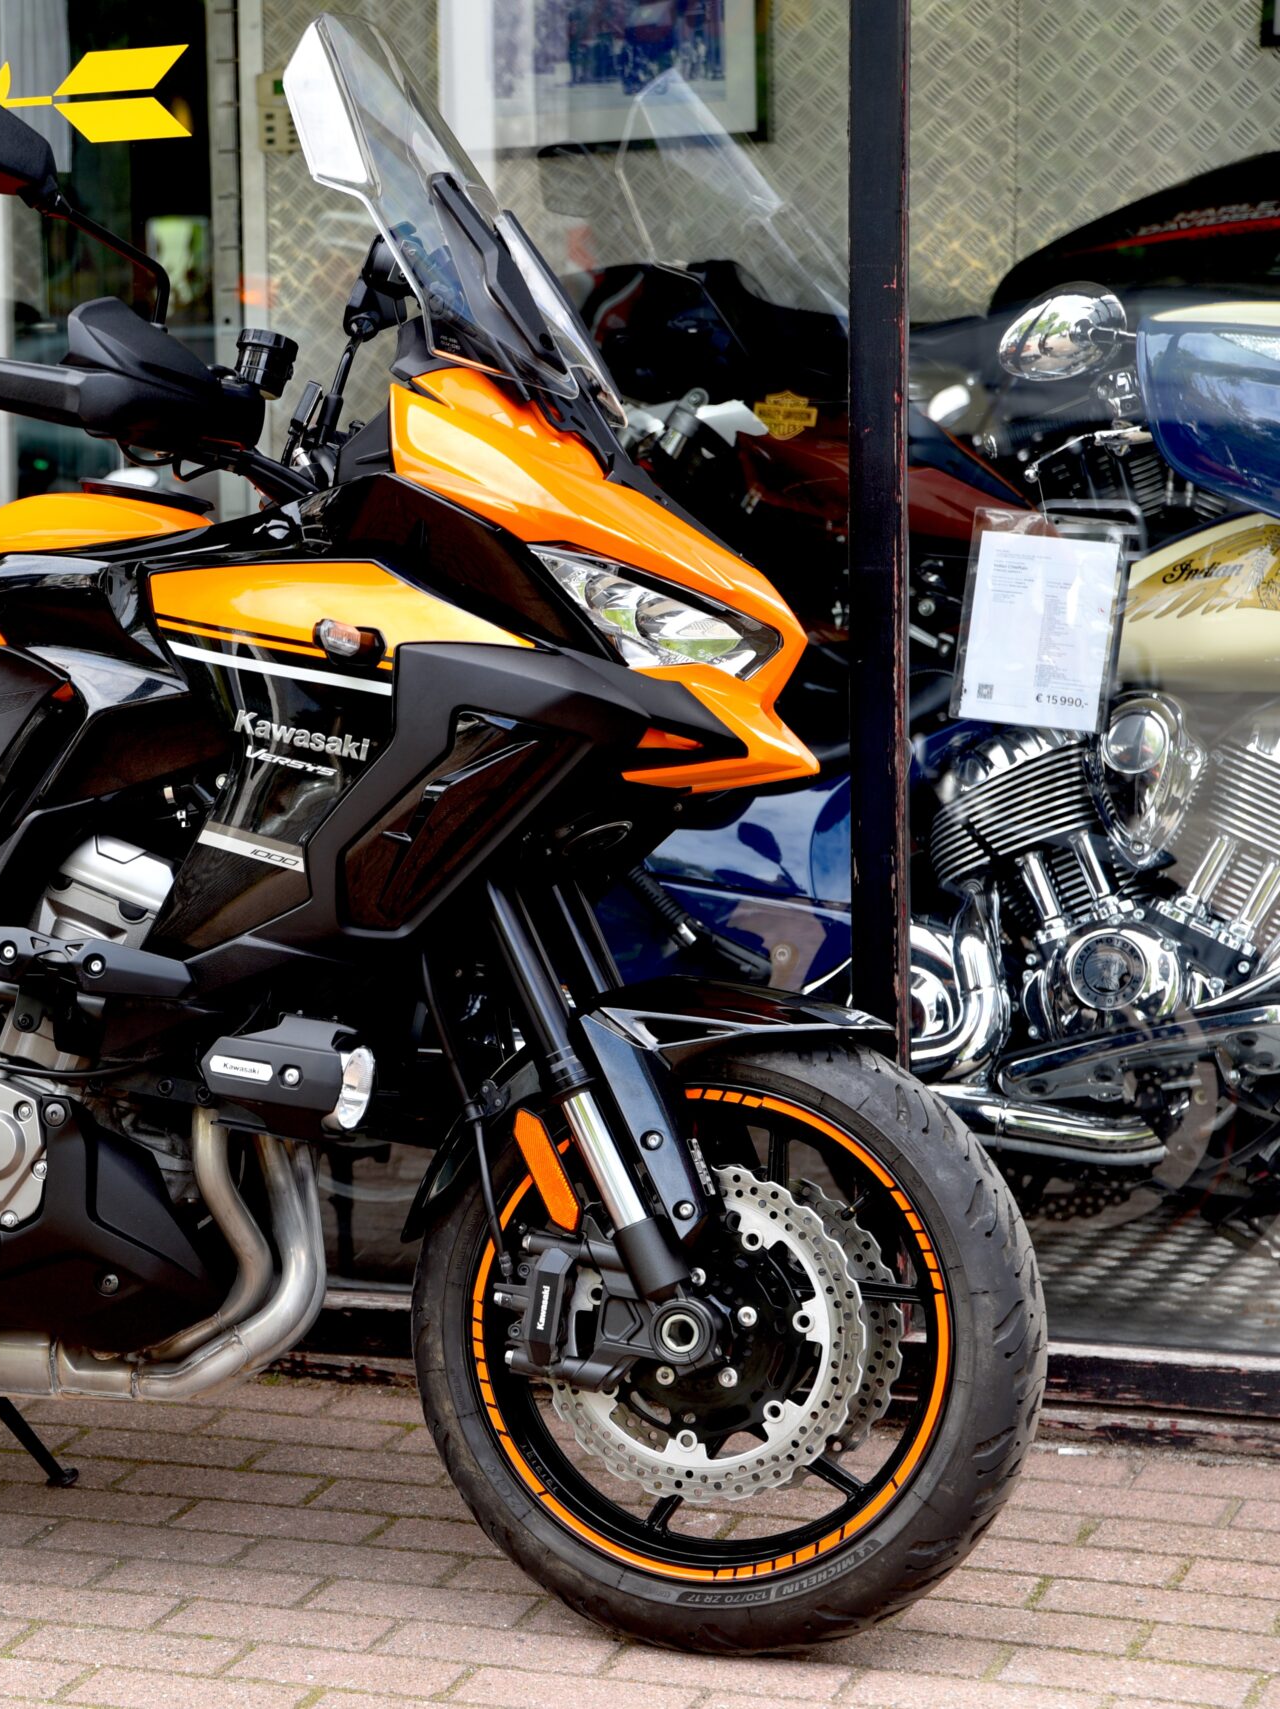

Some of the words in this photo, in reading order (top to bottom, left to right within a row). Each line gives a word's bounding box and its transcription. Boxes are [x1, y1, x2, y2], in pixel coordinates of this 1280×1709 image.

[1162, 559, 1244, 585] Indian
[1036, 693, 1044, 703] €
[233, 709, 371, 762] Kawasaki
[245, 745, 338, 777] VERSYS
[250, 848, 300, 867] 1000
[223, 1062, 260, 1075] Kawasaki
[536, 1284, 551, 1331] Kawasaki
[781, 1555, 855, 1595] MICHELIN
[687, 1593, 704, 1603] 17
[703, 1593, 723, 1604] ZR
[724, 1591, 768, 1604] 120/70
